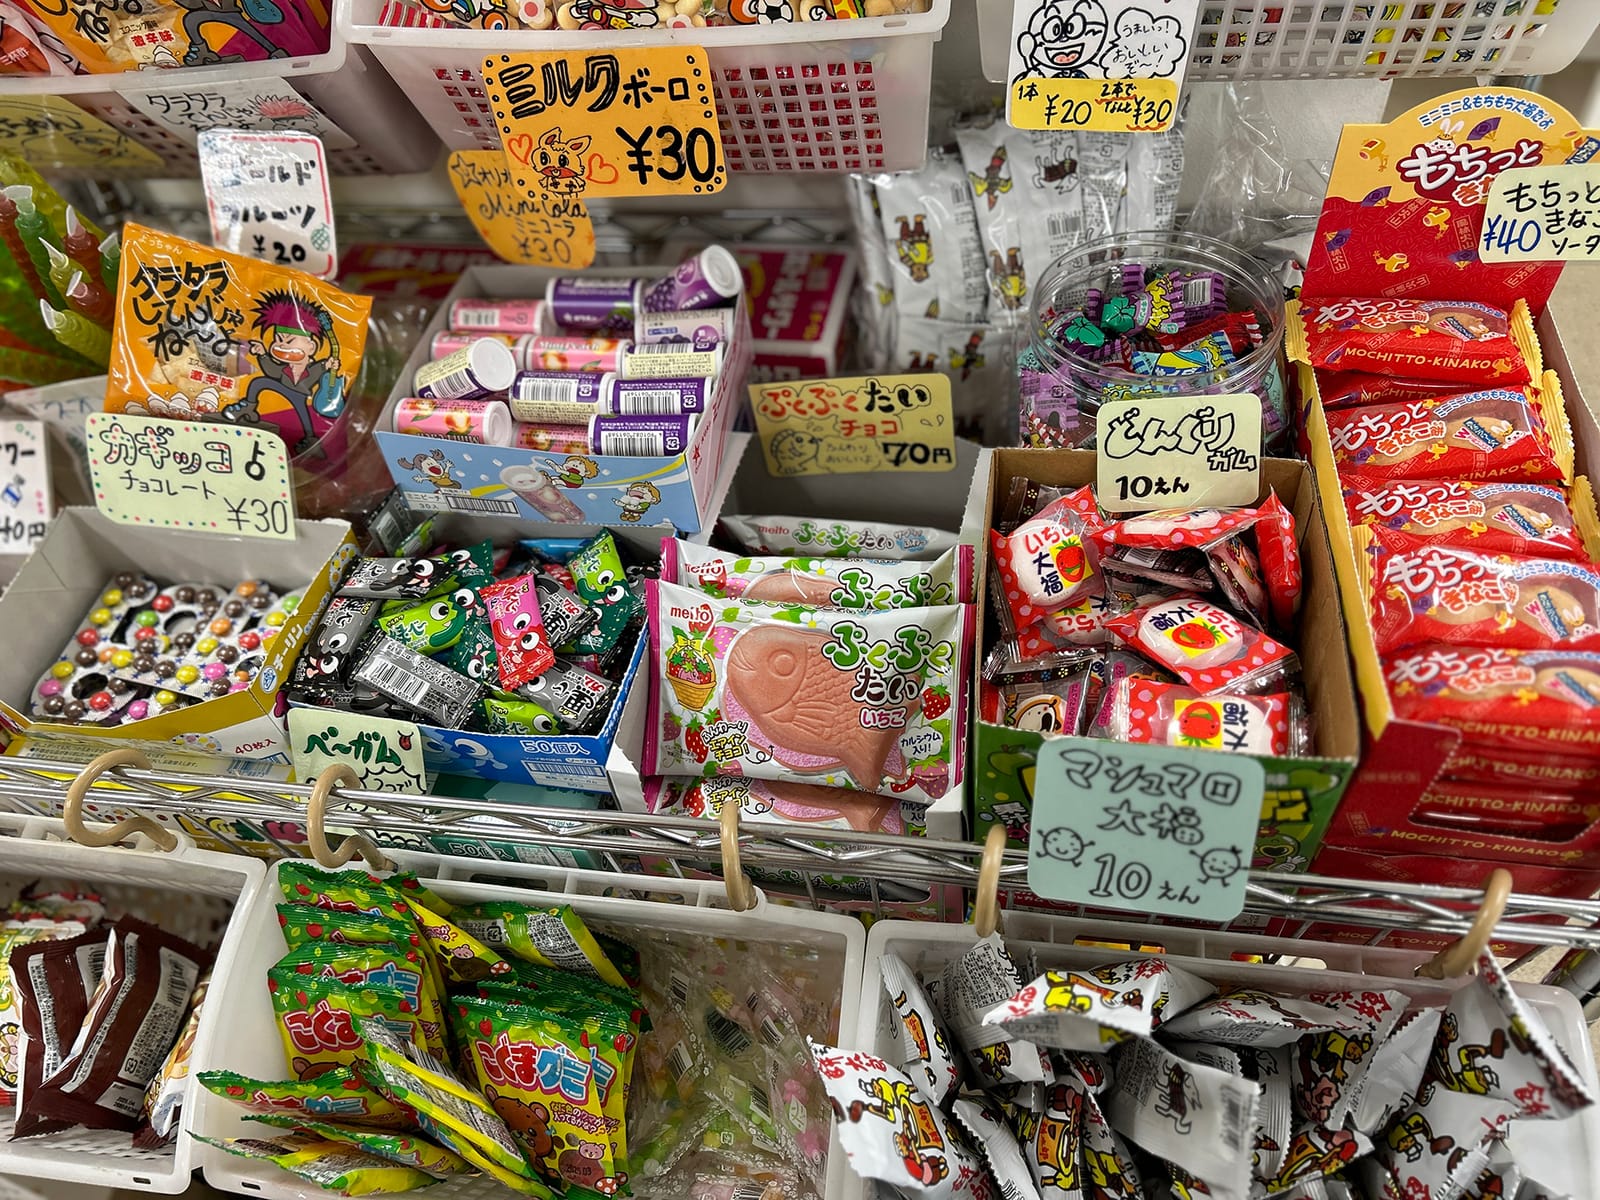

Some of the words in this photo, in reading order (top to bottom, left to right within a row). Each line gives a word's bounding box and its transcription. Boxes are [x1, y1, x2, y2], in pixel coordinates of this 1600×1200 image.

[131, 31, 175, 48] 激辛味
[145, 92, 226, 114] タラタラ
[1018, 83, 1039, 101] 1本
[1100, 82, 1137, 98] 2本で
[1045, 94, 1092, 125] ¥20
[1133, 96, 1173, 125] ¥30
[1418, 94, 1555, 131] ミニミニ&もちもち大福だよ
[616, 125, 717, 185] ¥30
[1400, 142, 1541, 191] もちっと
[1503, 180, 1600, 213] もちっと
[253, 234, 307, 263] ¥20
[1483, 214, 1542, 254] ¥40
[130, 260, 230, 302] タラタラ
[131, 293, 246, 330] してんじゃ
[1313, 298, 1414, 324] もちっと
[1345, 346, 1493, 370] MOCHITTO-KINAKO
[840, 419, 898, 437] チョコ
[1104, 407, 1235, 459] どんぐり
[1332, 400, 1428, 450] もちっと
[100, 422, 233, 475] カギッコ
[882, 442, 953, 467] 70円
[1207, 447, 1258, 472] ガム
[119, 470, 217, 499] チョコレート
[1115, 475, 1190, 500] 10えん
[1355, 481, 1466, 517] もちっと
[223, 497, 288, 535] ¥30
[758, 525, 790, 536] meito
[1032, 550, 1064, 597] 大福
[1148, 605, 1195, 632] 大福
[822, 620, 955, 671] ぷくぷく
[1389, 649, 1512, 684] もちっと
[850, 668, 922, 706] たい
[862, 710, 906, 727] いちご
[1222, 702, 1250, 752] 大福
[234, 738, 277, 756] 40枚入
[520, 740, 591, 756] 50個入
[708, 734, 748, 750] エアイン
[714, 743, 750, 762] チョコ!
[900, 731, 942, 748] カルシウム
[912, 743, 932, 756] 入り!
[1097, 799, 1204, 846] 大福
[1390, 829, 1560, 858] MOCHITTO-KINAKO
[1089, 853, 1200, 905] 10えん
[475, 1030, 592, 1106] こぐまグミ
